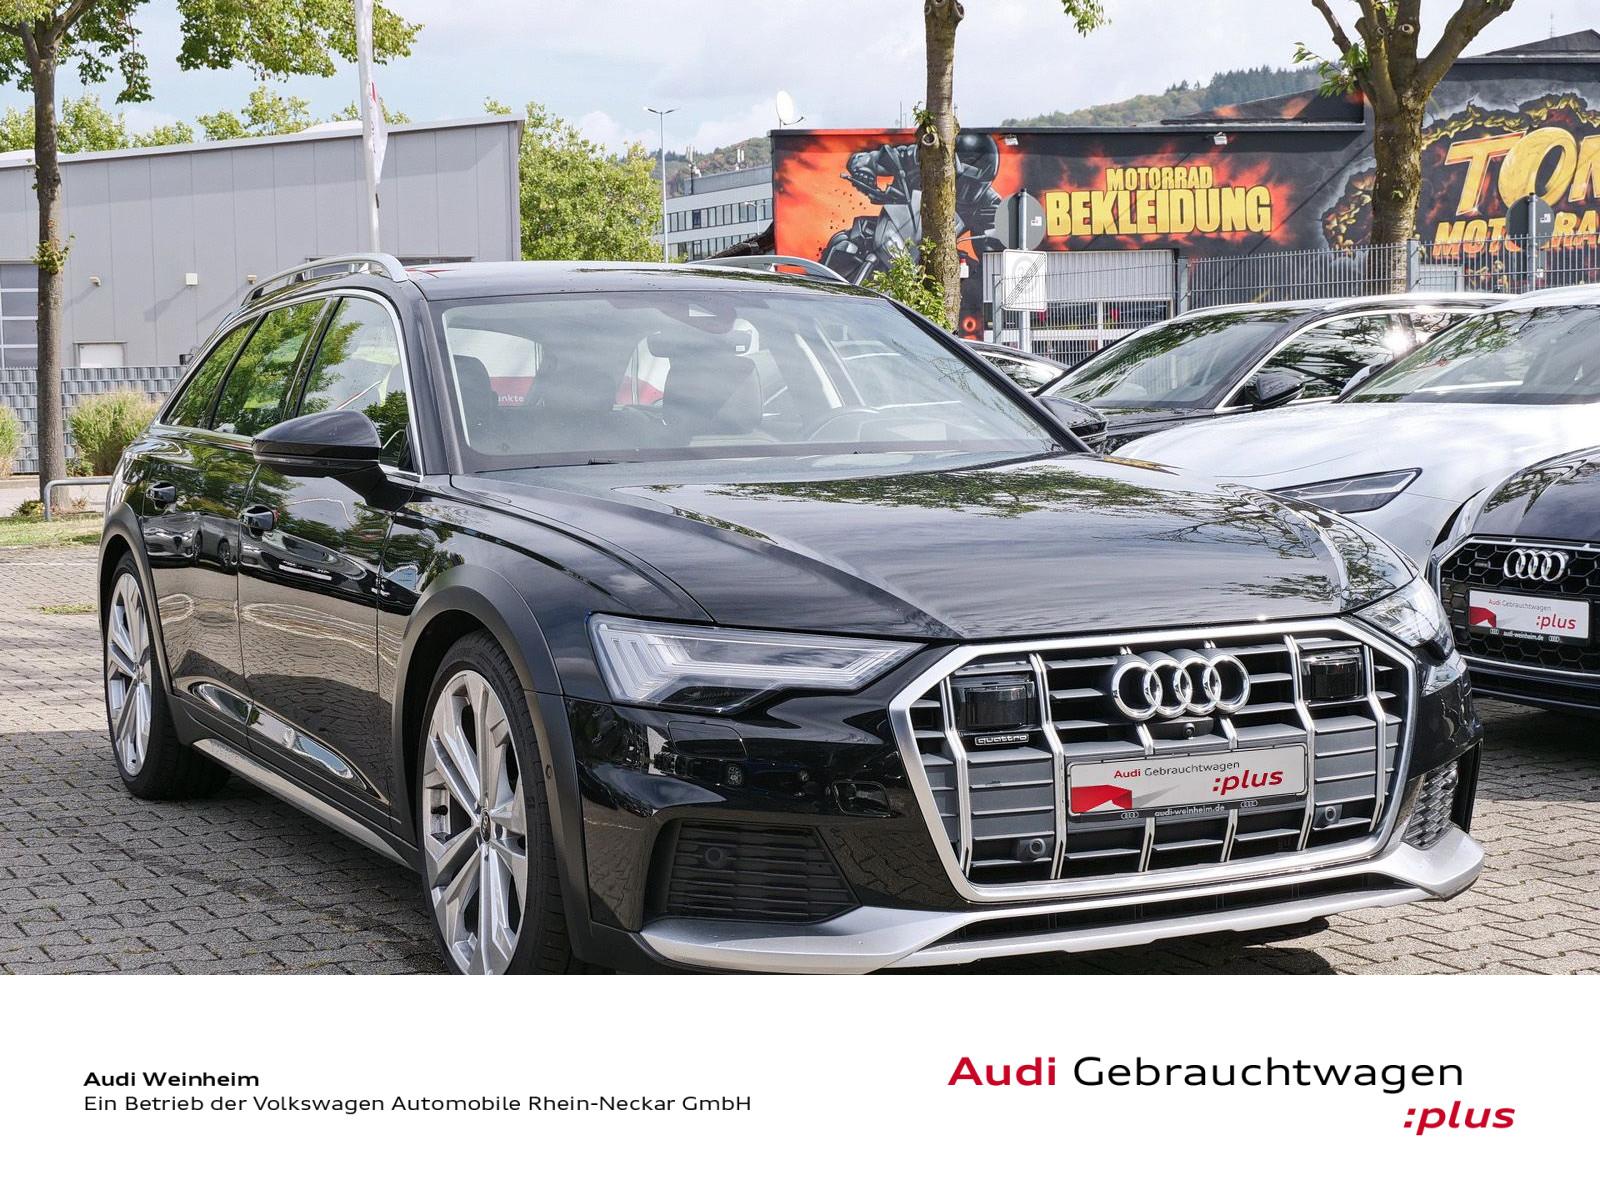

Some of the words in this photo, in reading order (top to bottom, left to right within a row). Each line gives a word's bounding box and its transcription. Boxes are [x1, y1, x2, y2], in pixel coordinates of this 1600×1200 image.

[1106, 166, 1213, 191] MOTORRAD
[1045, 186, 1272, 236] BEKLEIDUNG
[1536, 613, 1577, 630] :plus
[978, 735, 1027, 744] quattro
[1113, 768, 1141, 779] Audi
[1144, 761, 1240, 777] Gebrauchtwagen
[1212, 769, 1283, 796] :plus
[1154, 805, 1225, 817] audi-weinheim.de
